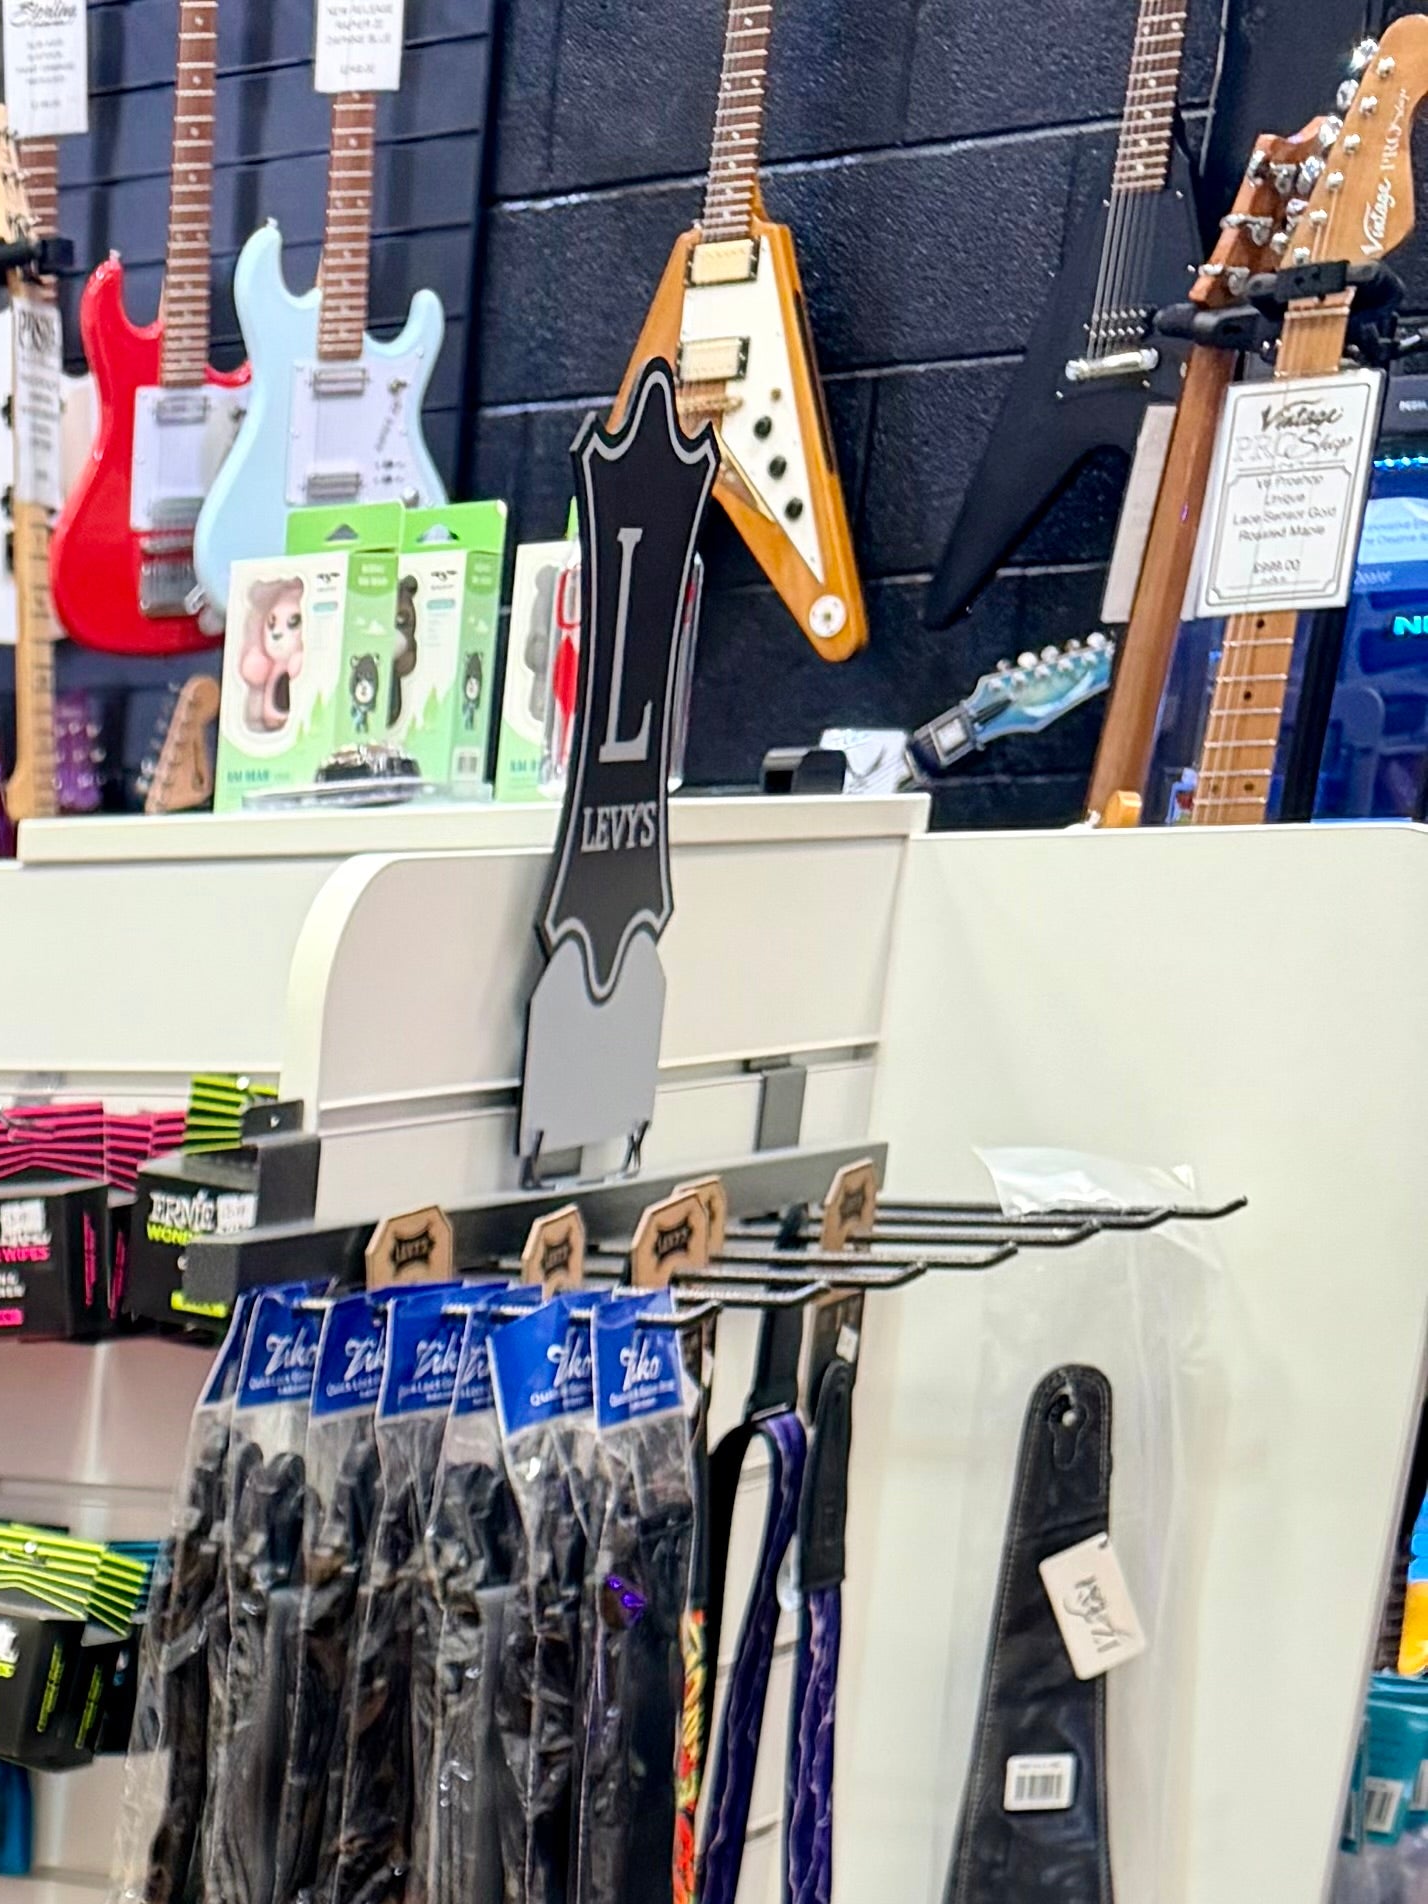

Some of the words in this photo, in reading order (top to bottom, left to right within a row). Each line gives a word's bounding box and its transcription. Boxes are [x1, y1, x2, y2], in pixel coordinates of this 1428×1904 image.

[1360, 177, 1396, 256] Vintage
[1261, 398, 1344, 432] Vintage
[599, 527, 653, 763] L
[580, 801, 657, 852] LEVY'S
[148, 1188, 216, 1232] ERNIE
[1, 1244, 51, 1262] WIPES
[345, 1328, 386, 1381] Zik
